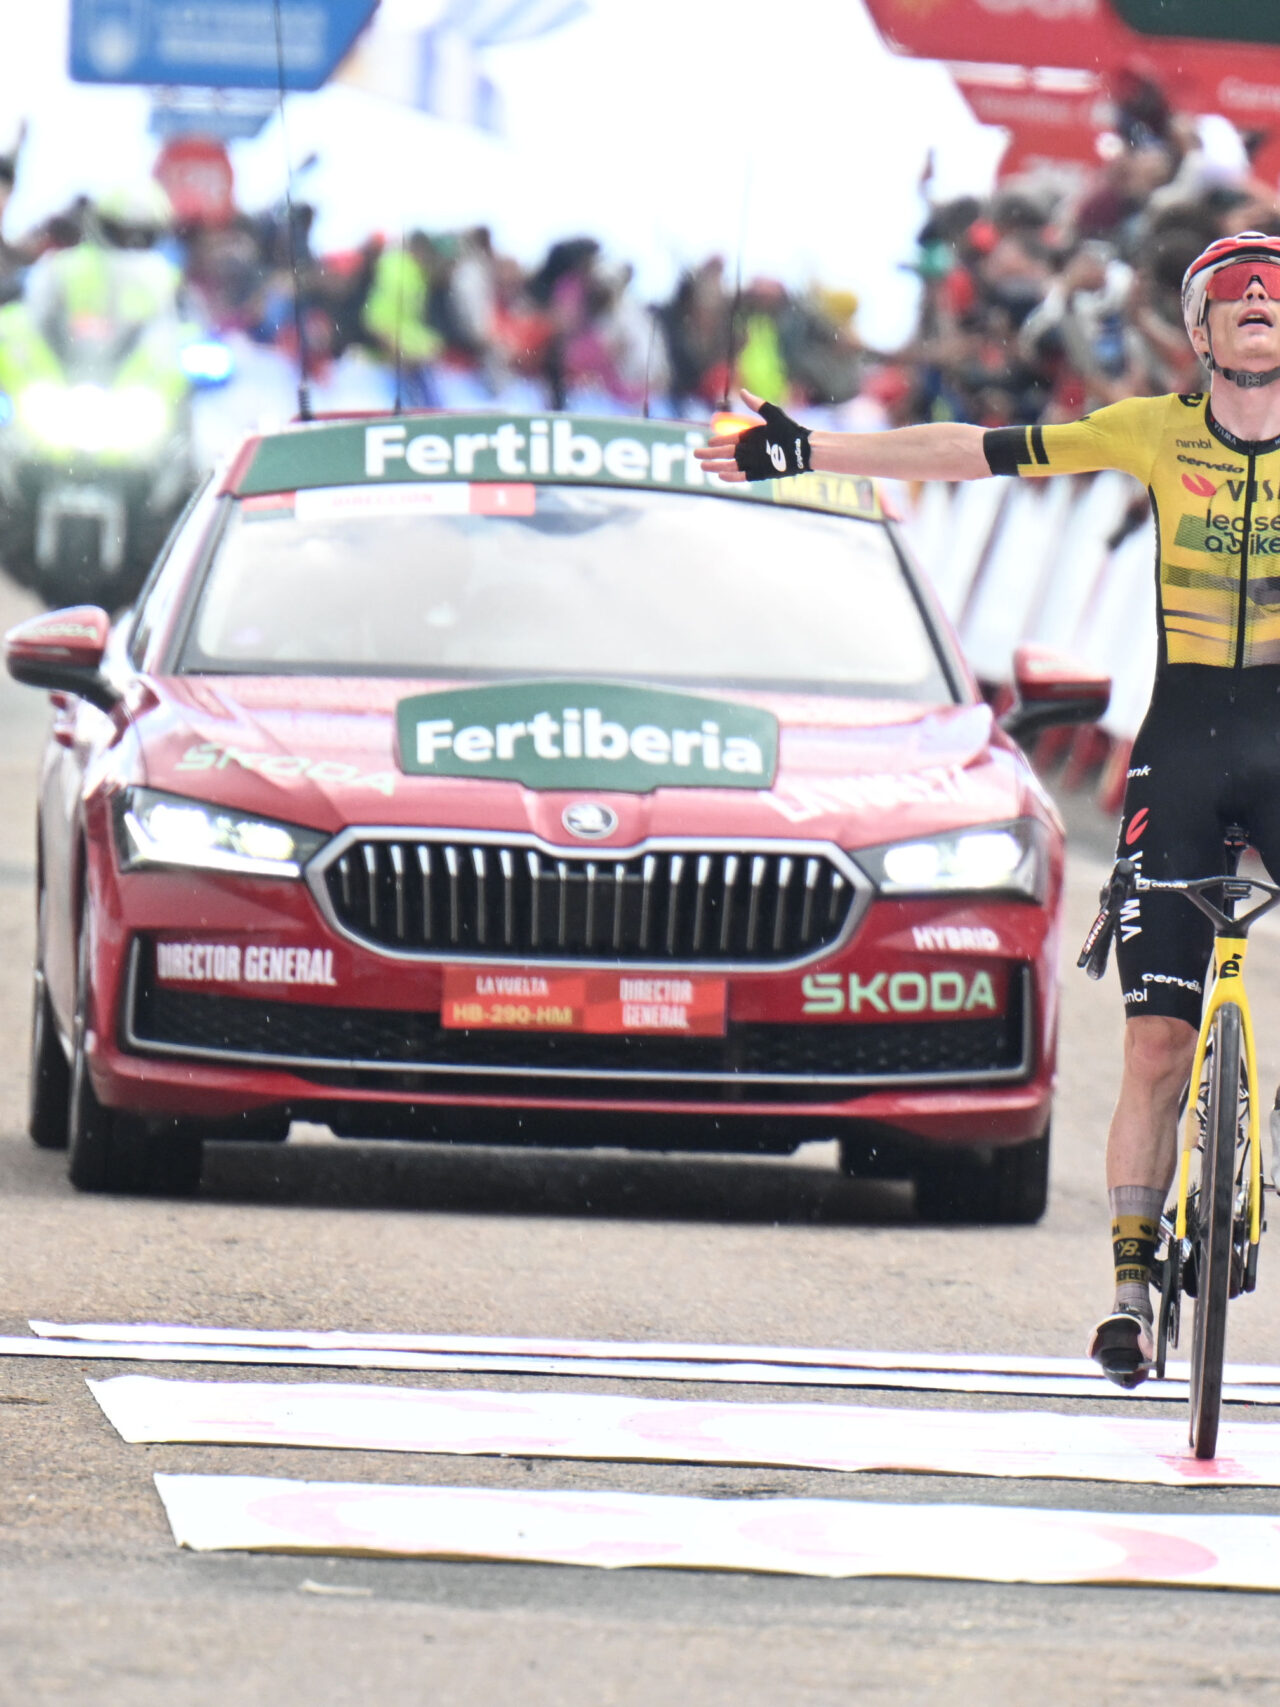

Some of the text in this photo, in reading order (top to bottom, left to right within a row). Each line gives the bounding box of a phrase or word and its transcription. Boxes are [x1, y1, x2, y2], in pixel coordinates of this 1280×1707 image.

[1175, 438, 1213, 450] nimbl
[416, 708, 763, 775] Fertiberia
[1127, 765, 1151, 778] ank
[912, 926, 1000, 950] HYBRID
[157, 943, 338, 986] DIRECTOR GENERAL
[619, 978, 694, 1003] DIRECTOR
[453, 1002, 573, 1026] HB-290-HM
[622, 1004, 689, 1028] GENERAL
